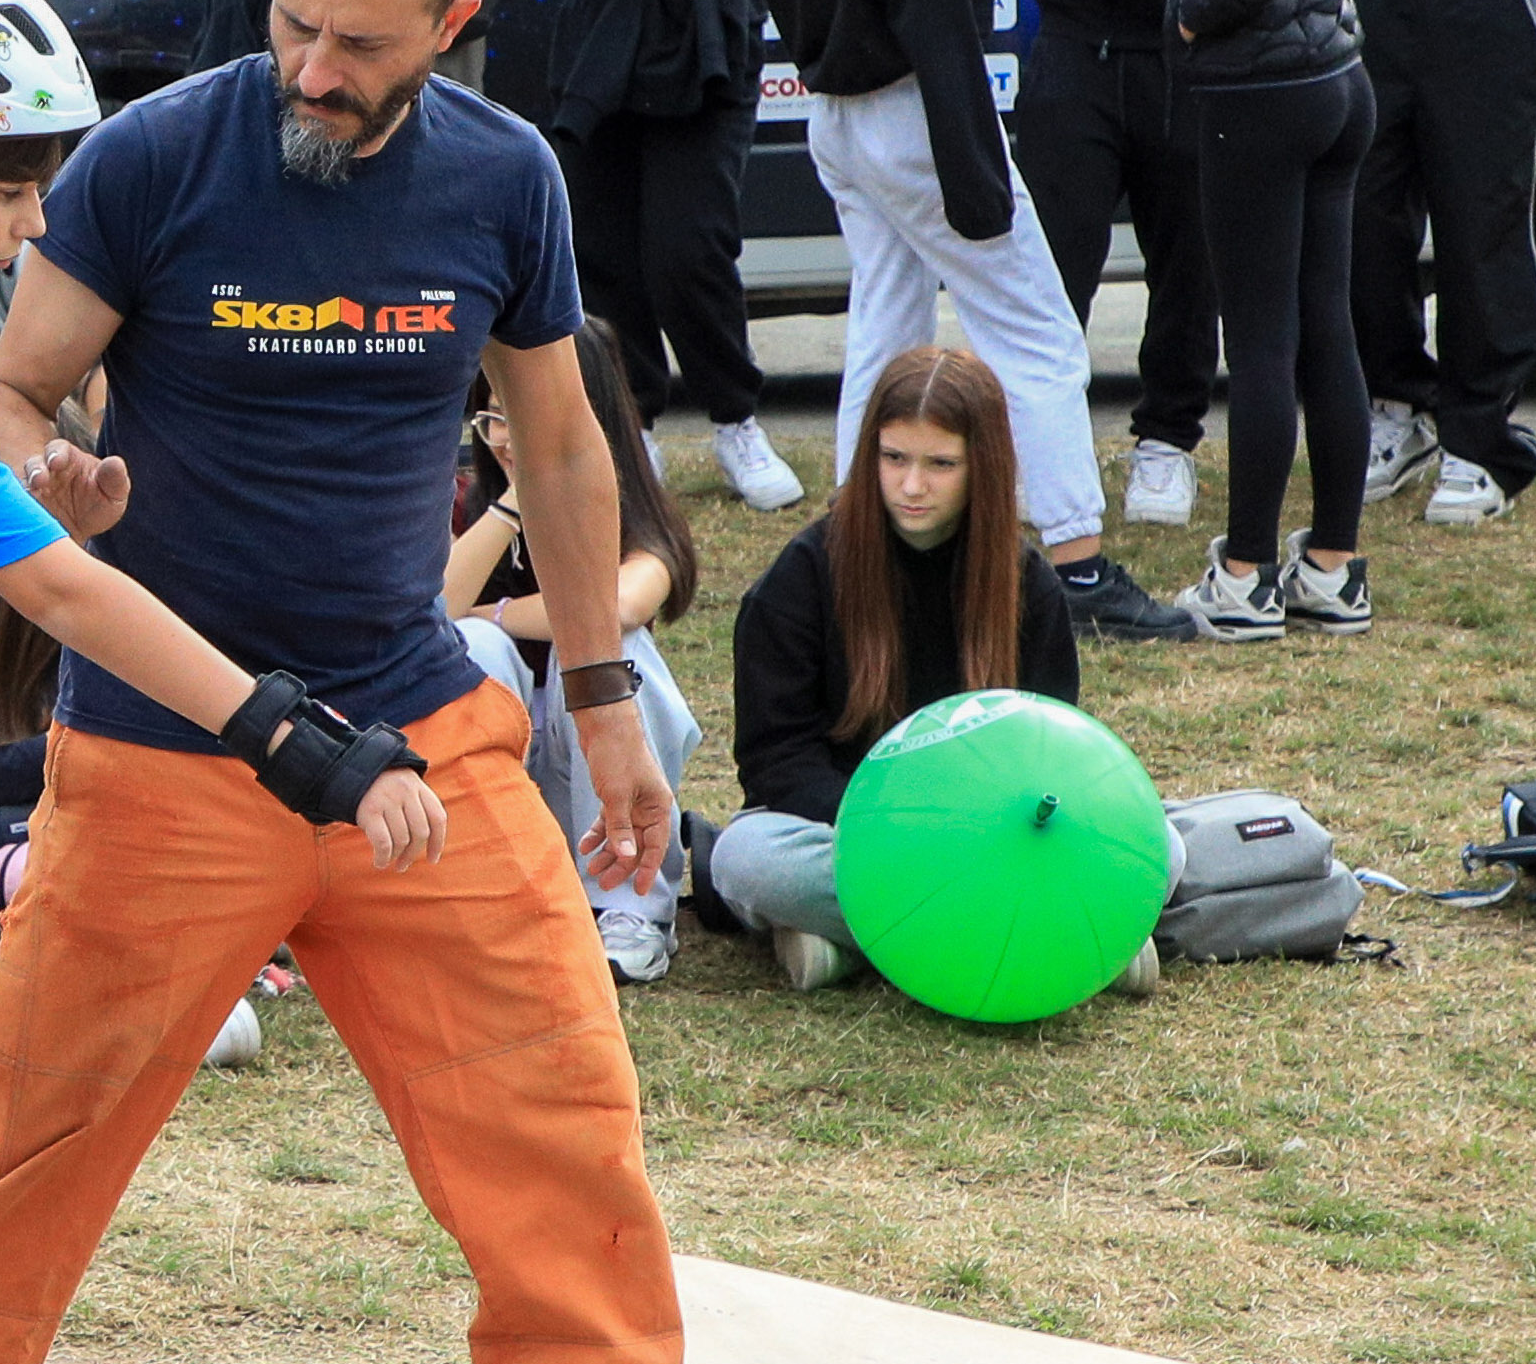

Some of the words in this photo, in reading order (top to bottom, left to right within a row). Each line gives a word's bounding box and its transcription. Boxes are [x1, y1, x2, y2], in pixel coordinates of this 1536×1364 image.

[211, 300, 315, 332] SK8
[374, 304, 457, 334] TEK
[247, 336, 358, 355] SKATEBOARD
[364, 336, 427, 354] SCHOOL
